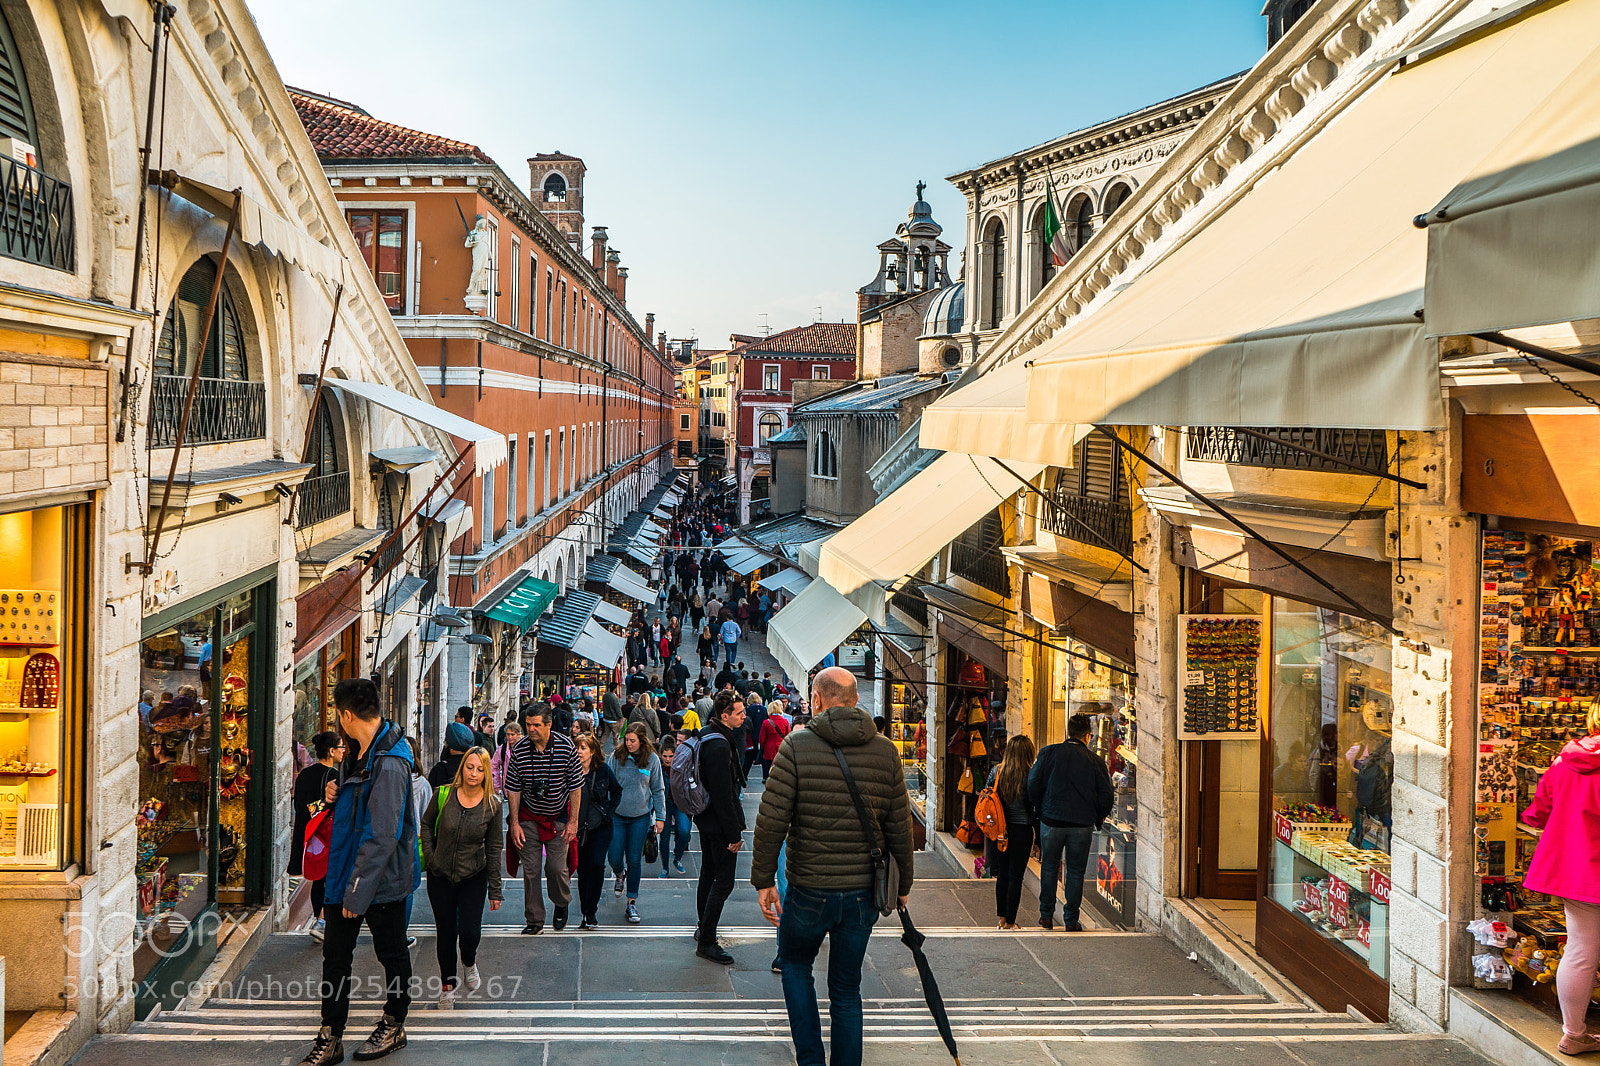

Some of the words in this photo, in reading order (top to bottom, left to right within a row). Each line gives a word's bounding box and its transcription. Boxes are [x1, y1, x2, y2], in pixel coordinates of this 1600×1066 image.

[1484, 458, 1495, 477] 6
[1276, 817, 1291, 840] 1,00
[1329, 876, 1348, 903] 2,00
[1370, 872, 1391, 900] 1,00
[1329, 901, 1347, 927] 2,00
